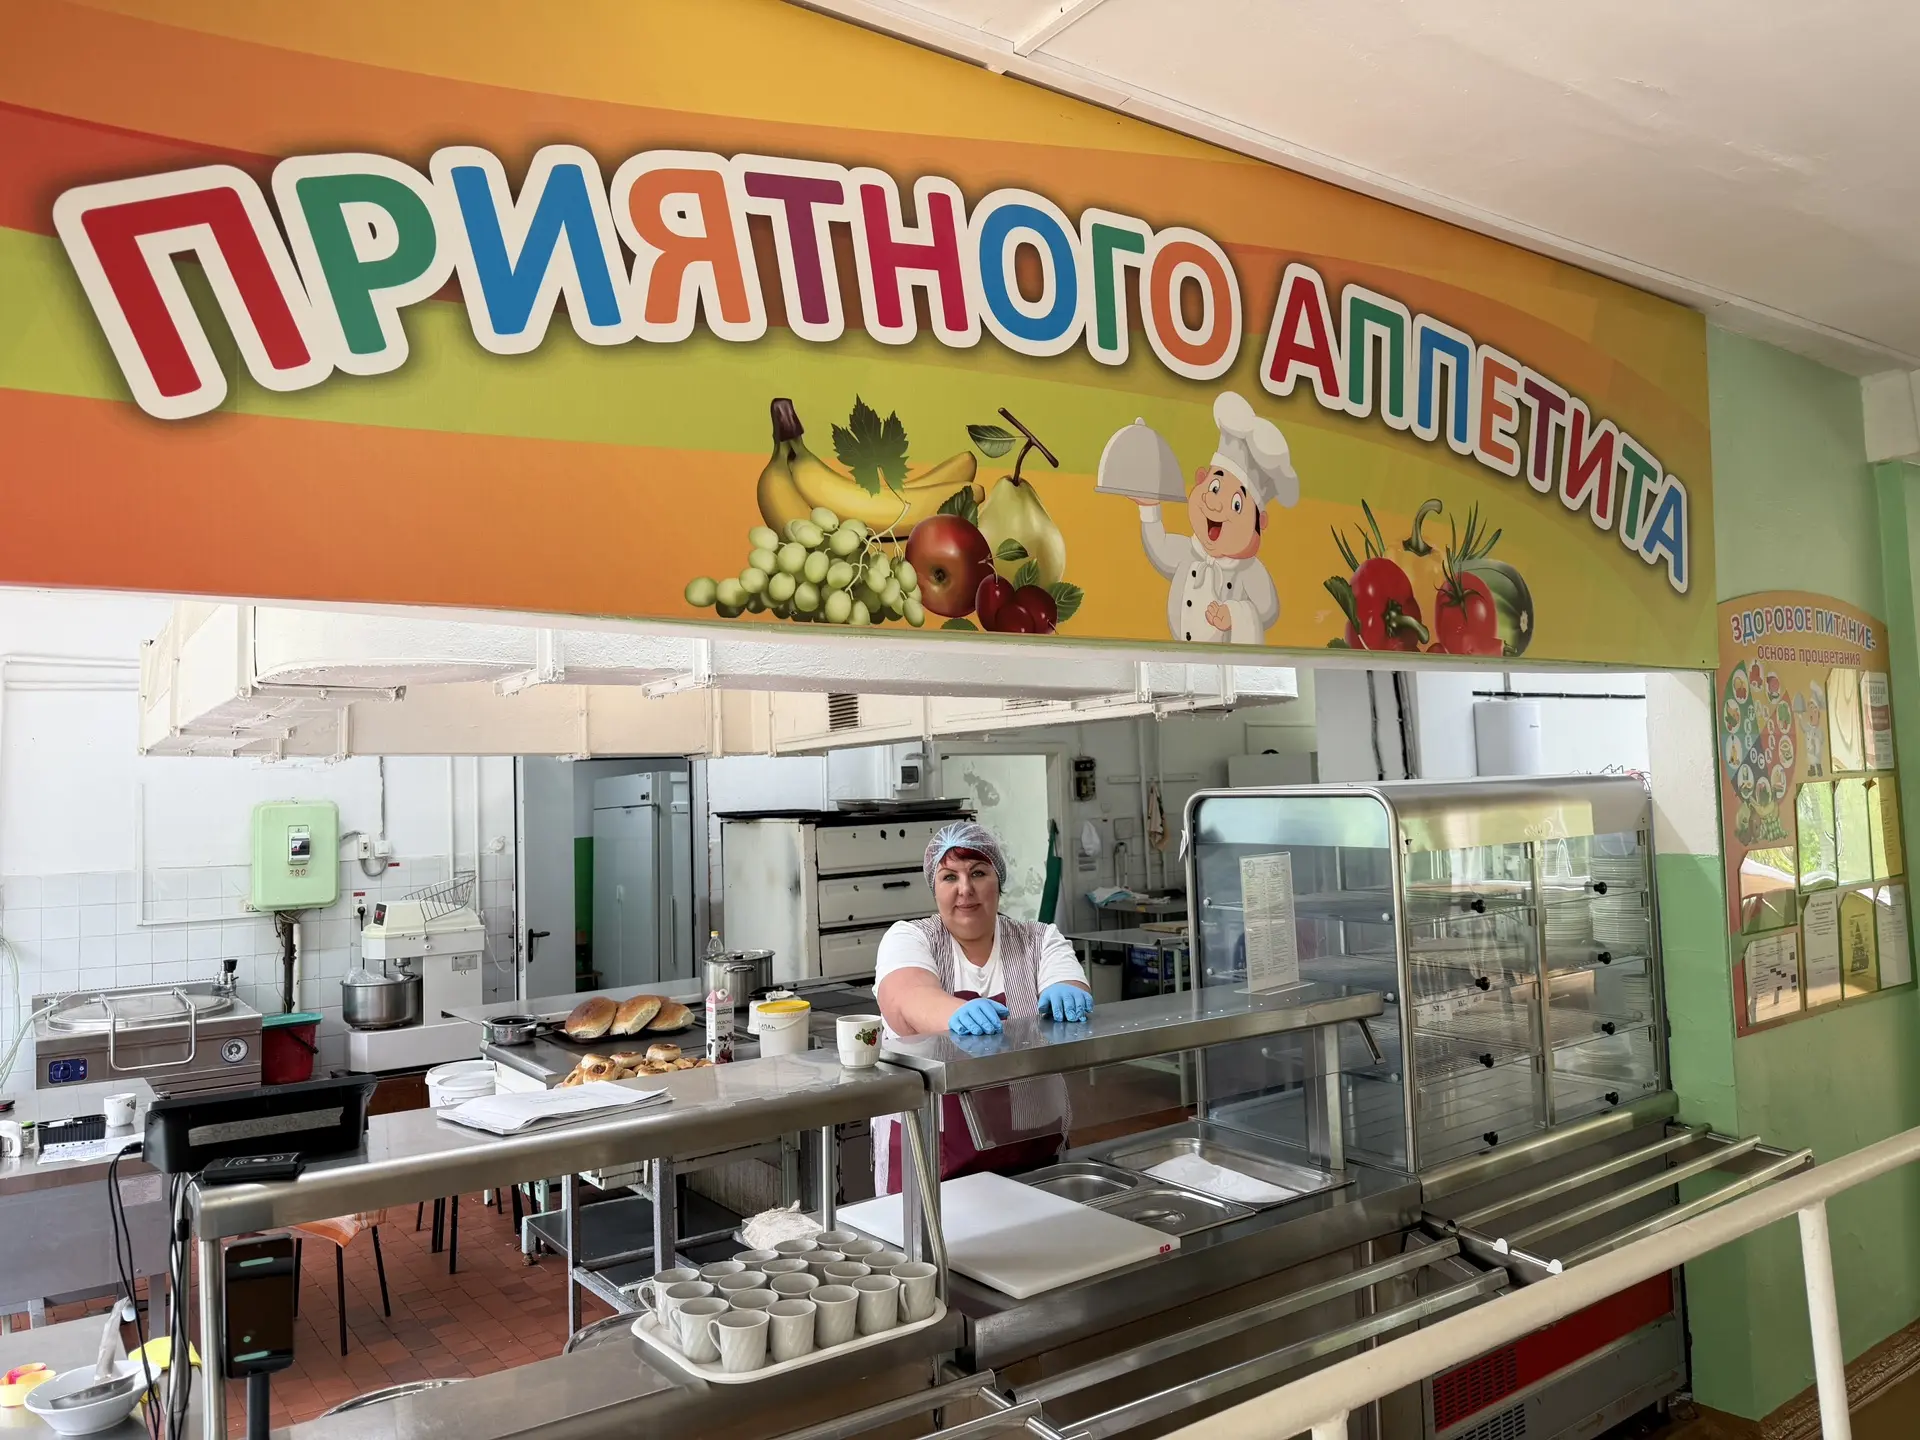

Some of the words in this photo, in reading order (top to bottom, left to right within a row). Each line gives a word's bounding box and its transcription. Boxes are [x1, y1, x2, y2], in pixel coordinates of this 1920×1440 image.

[56, 146, 1243, 420] ПРИЯТНОГО
[1263, 265, 1690, 592] АППЕТИТА
[1731, 606, 1812, 645] ЗДОРОВОЕ
[1757, 645, 1796, 662] основа
[1799, 648, 1861, 667] процветания
